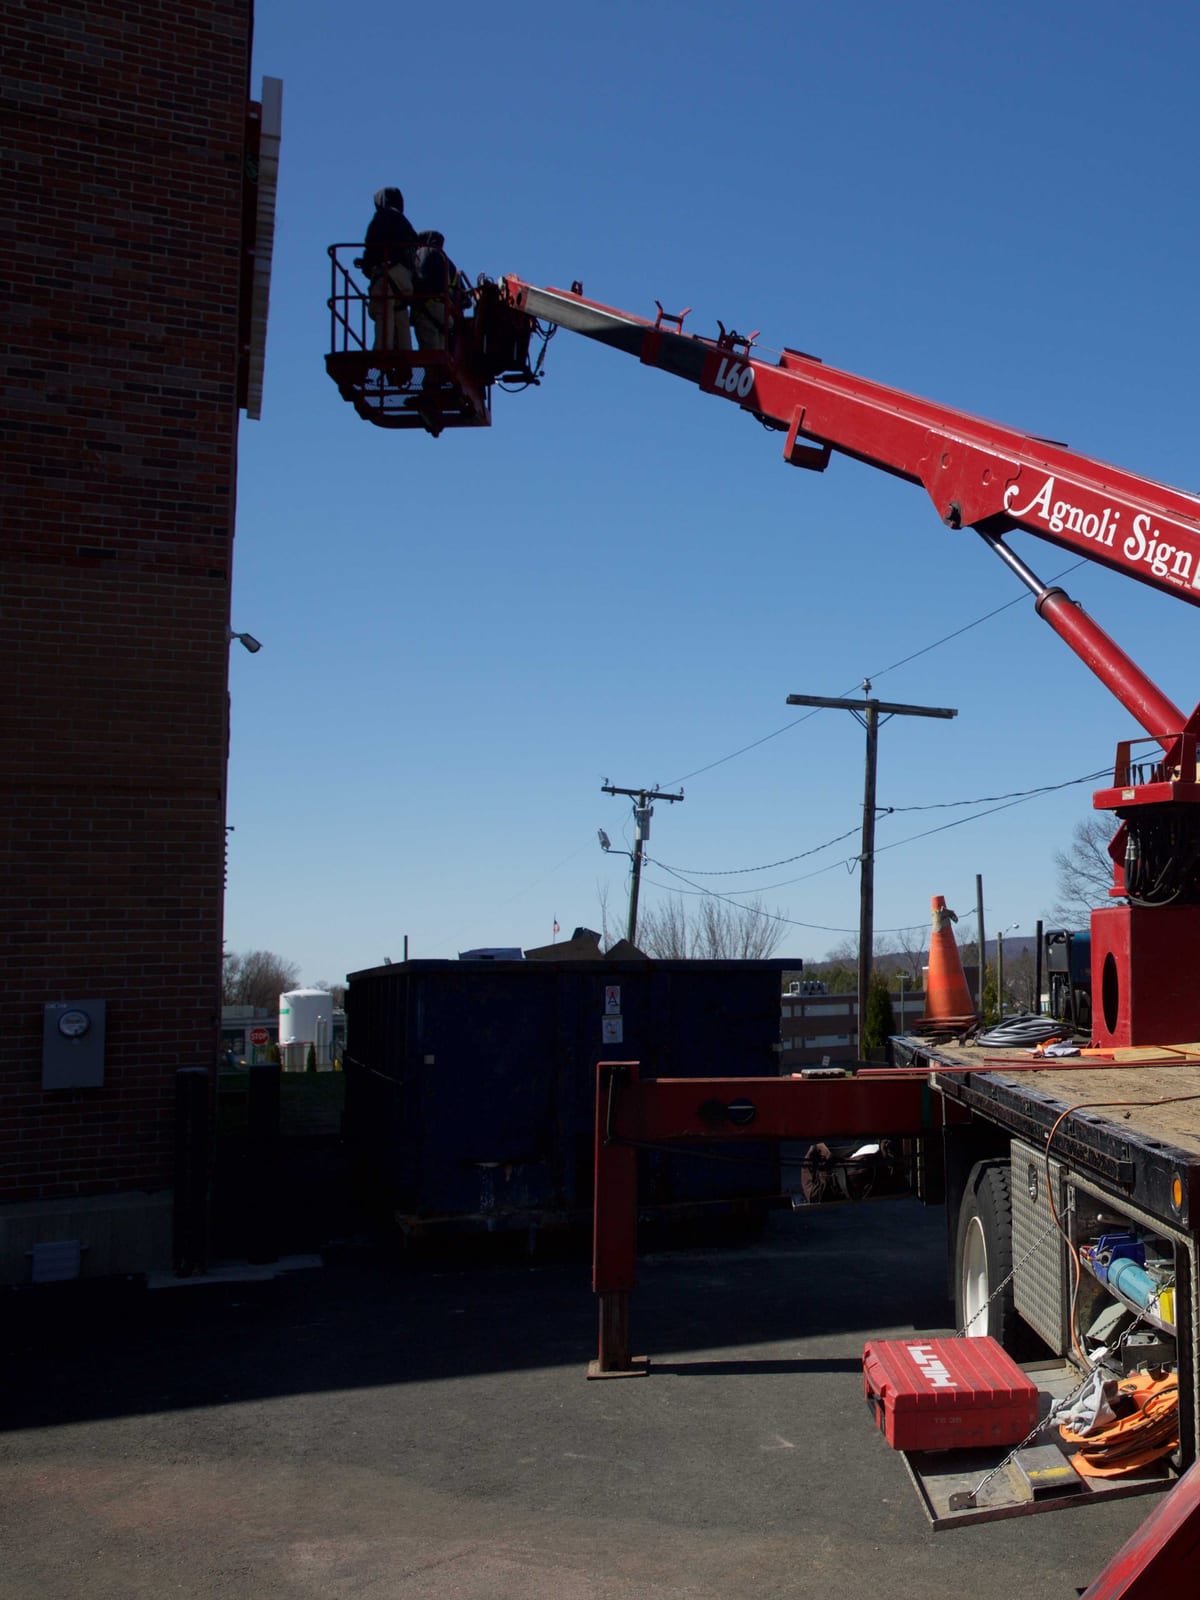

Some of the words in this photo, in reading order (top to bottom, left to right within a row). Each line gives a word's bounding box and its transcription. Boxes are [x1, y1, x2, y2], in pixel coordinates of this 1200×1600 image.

[714, 357, 755, 398] L60
[1003, 476, 1120, 547] Agnoli
[1123, 514, 1193, 578] Sign
[250, 1032, 269, 1041] STOP
[906, 1345, 958, 1389] HILTI
